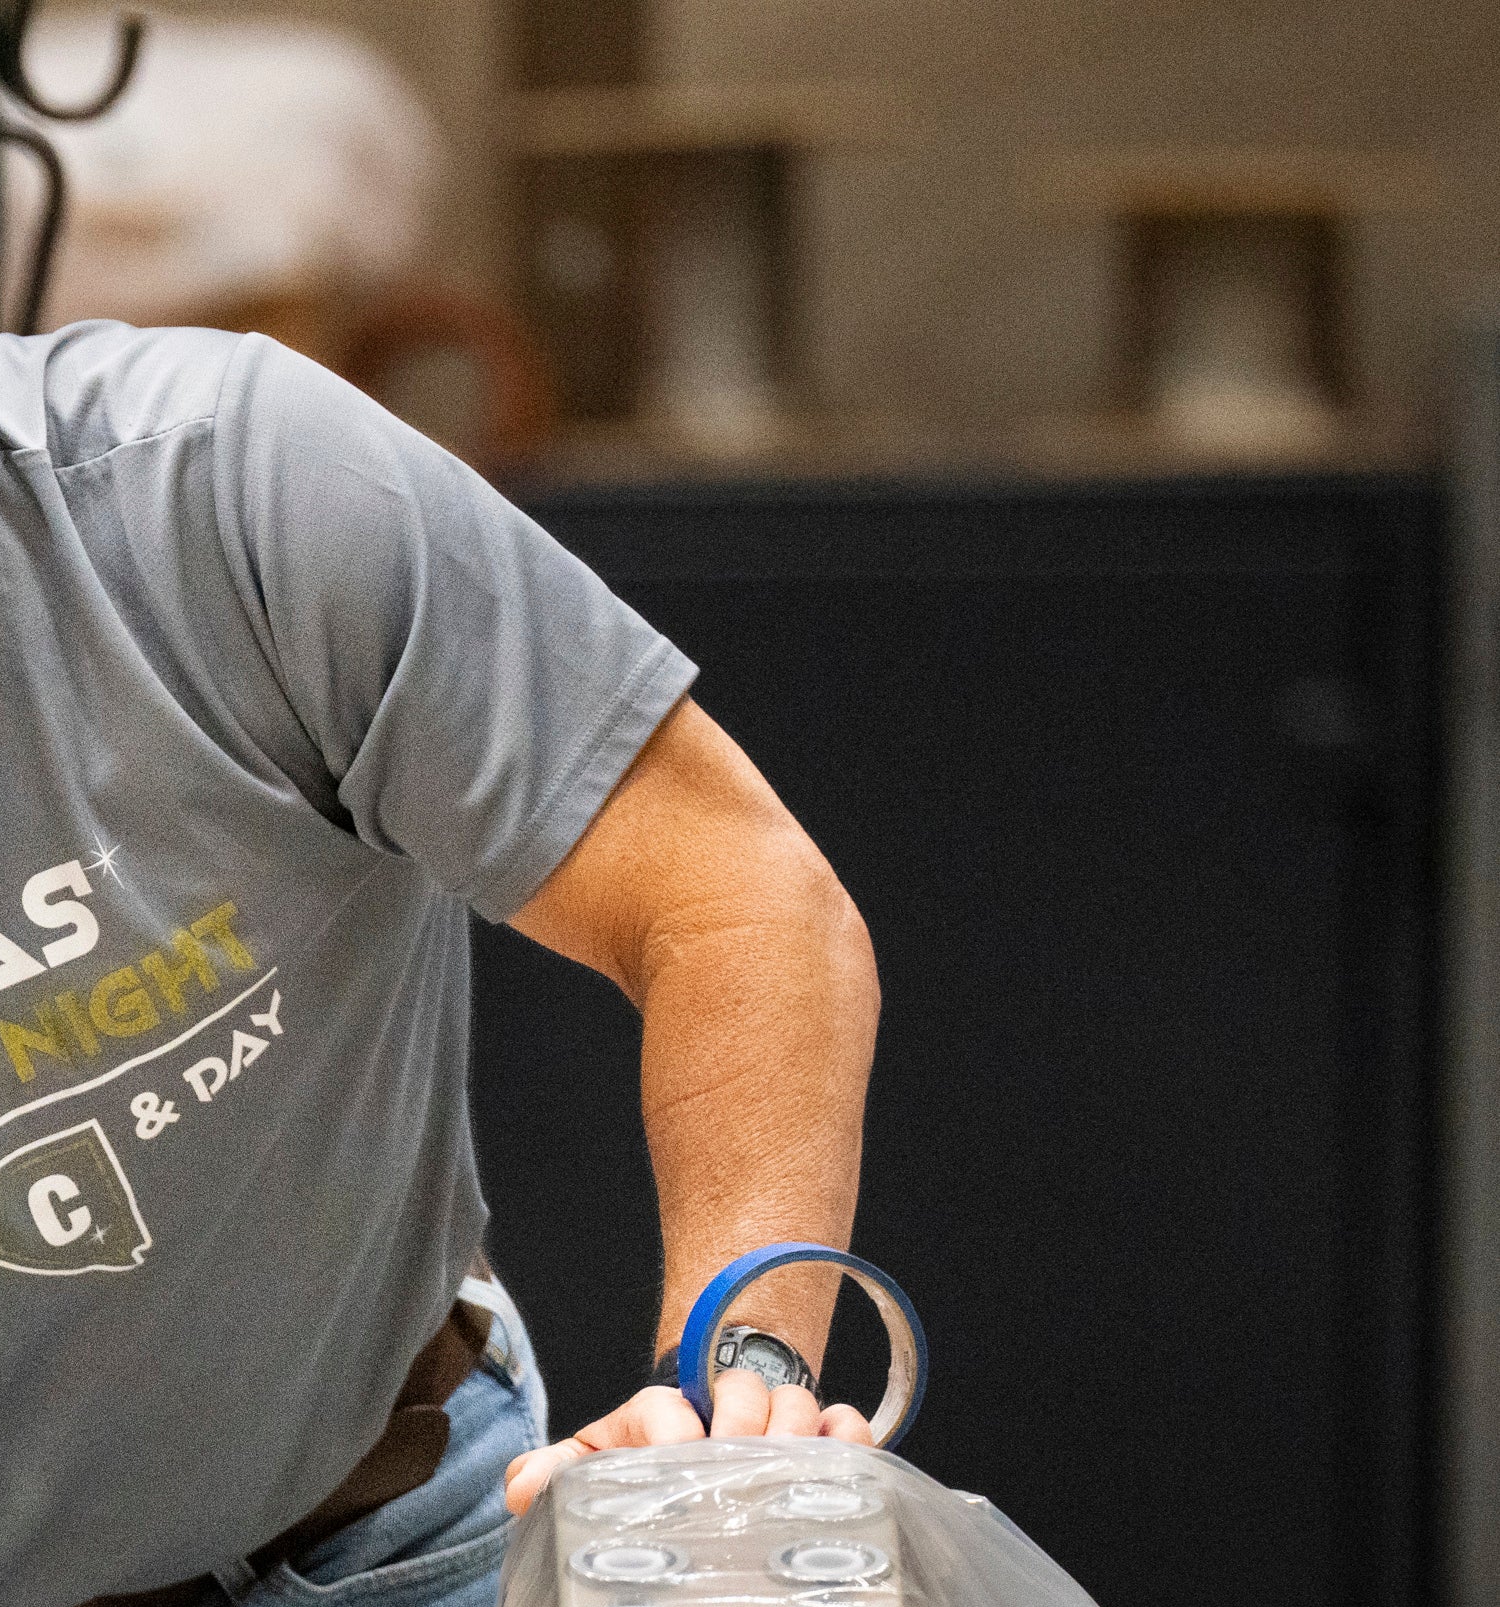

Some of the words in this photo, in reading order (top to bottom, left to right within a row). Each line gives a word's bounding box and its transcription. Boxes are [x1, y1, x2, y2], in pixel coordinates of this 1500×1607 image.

[130, 1092, 181, 1140] &
[182, 988, 284, 1102] DAY
[27, 1174, 91, 1246] C
